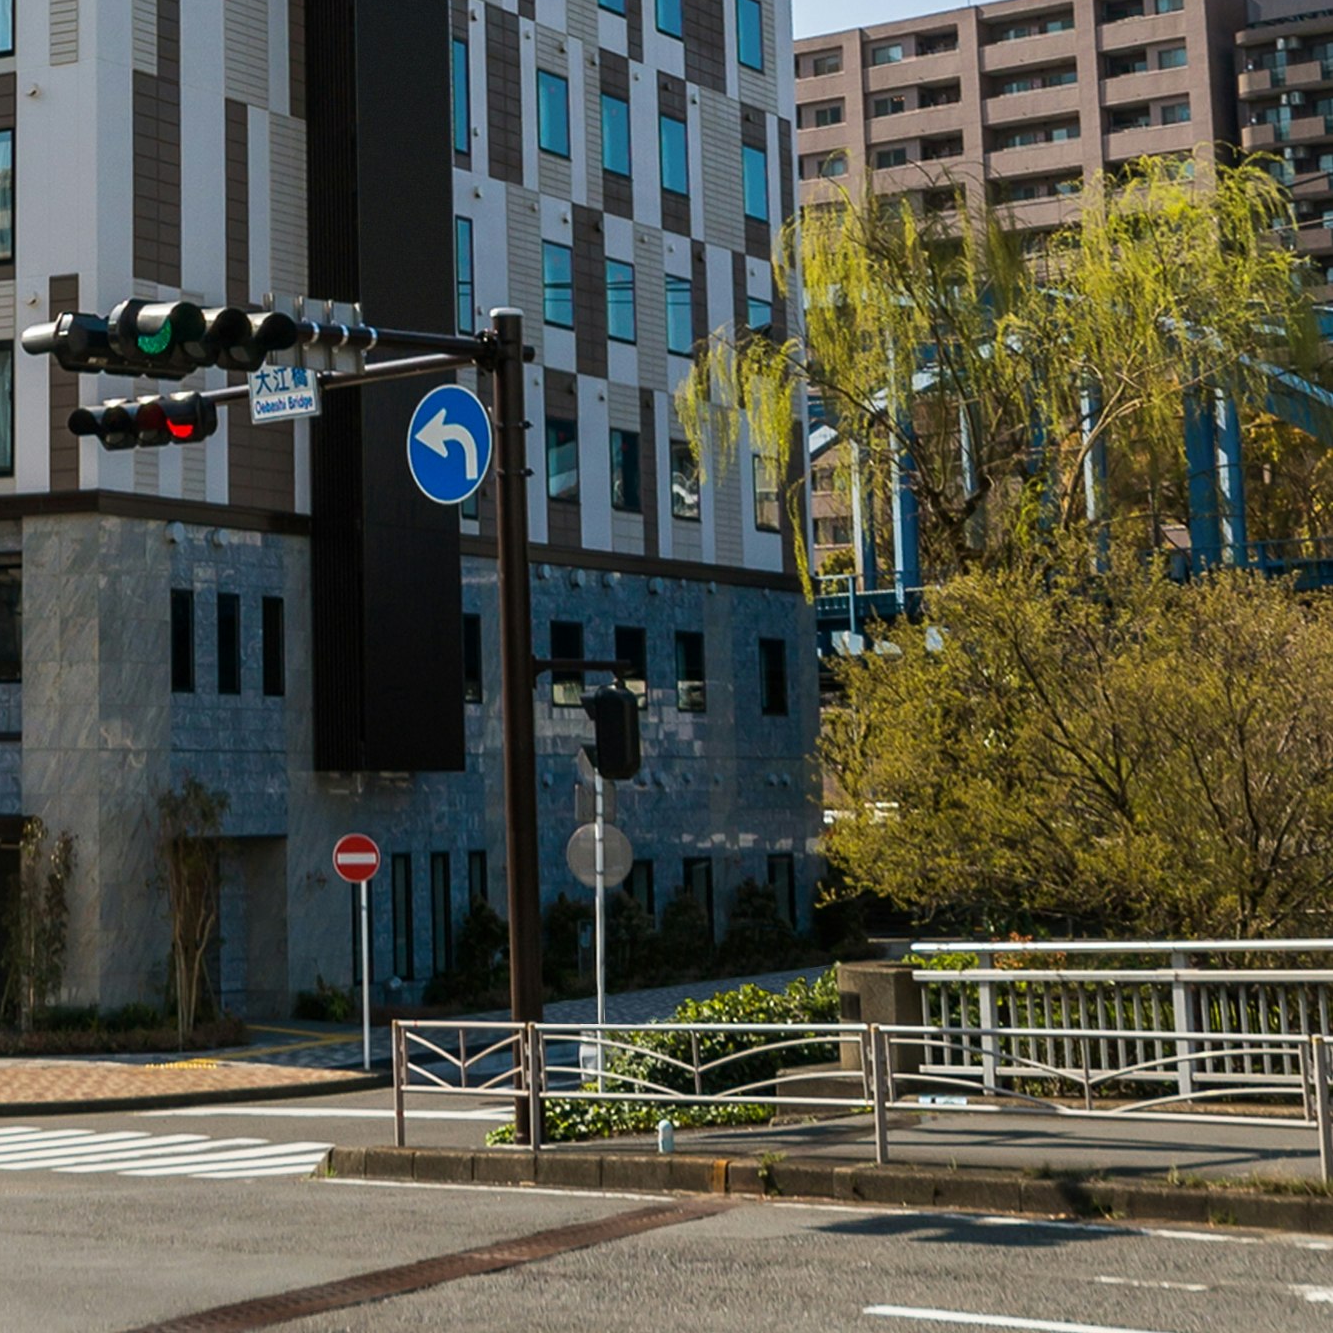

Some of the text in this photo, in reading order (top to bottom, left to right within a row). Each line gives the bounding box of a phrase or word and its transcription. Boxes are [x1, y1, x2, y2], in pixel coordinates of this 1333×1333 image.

[255, 366, 308, 395] 大江橋
[288, 394, 313, 410] Bridge
